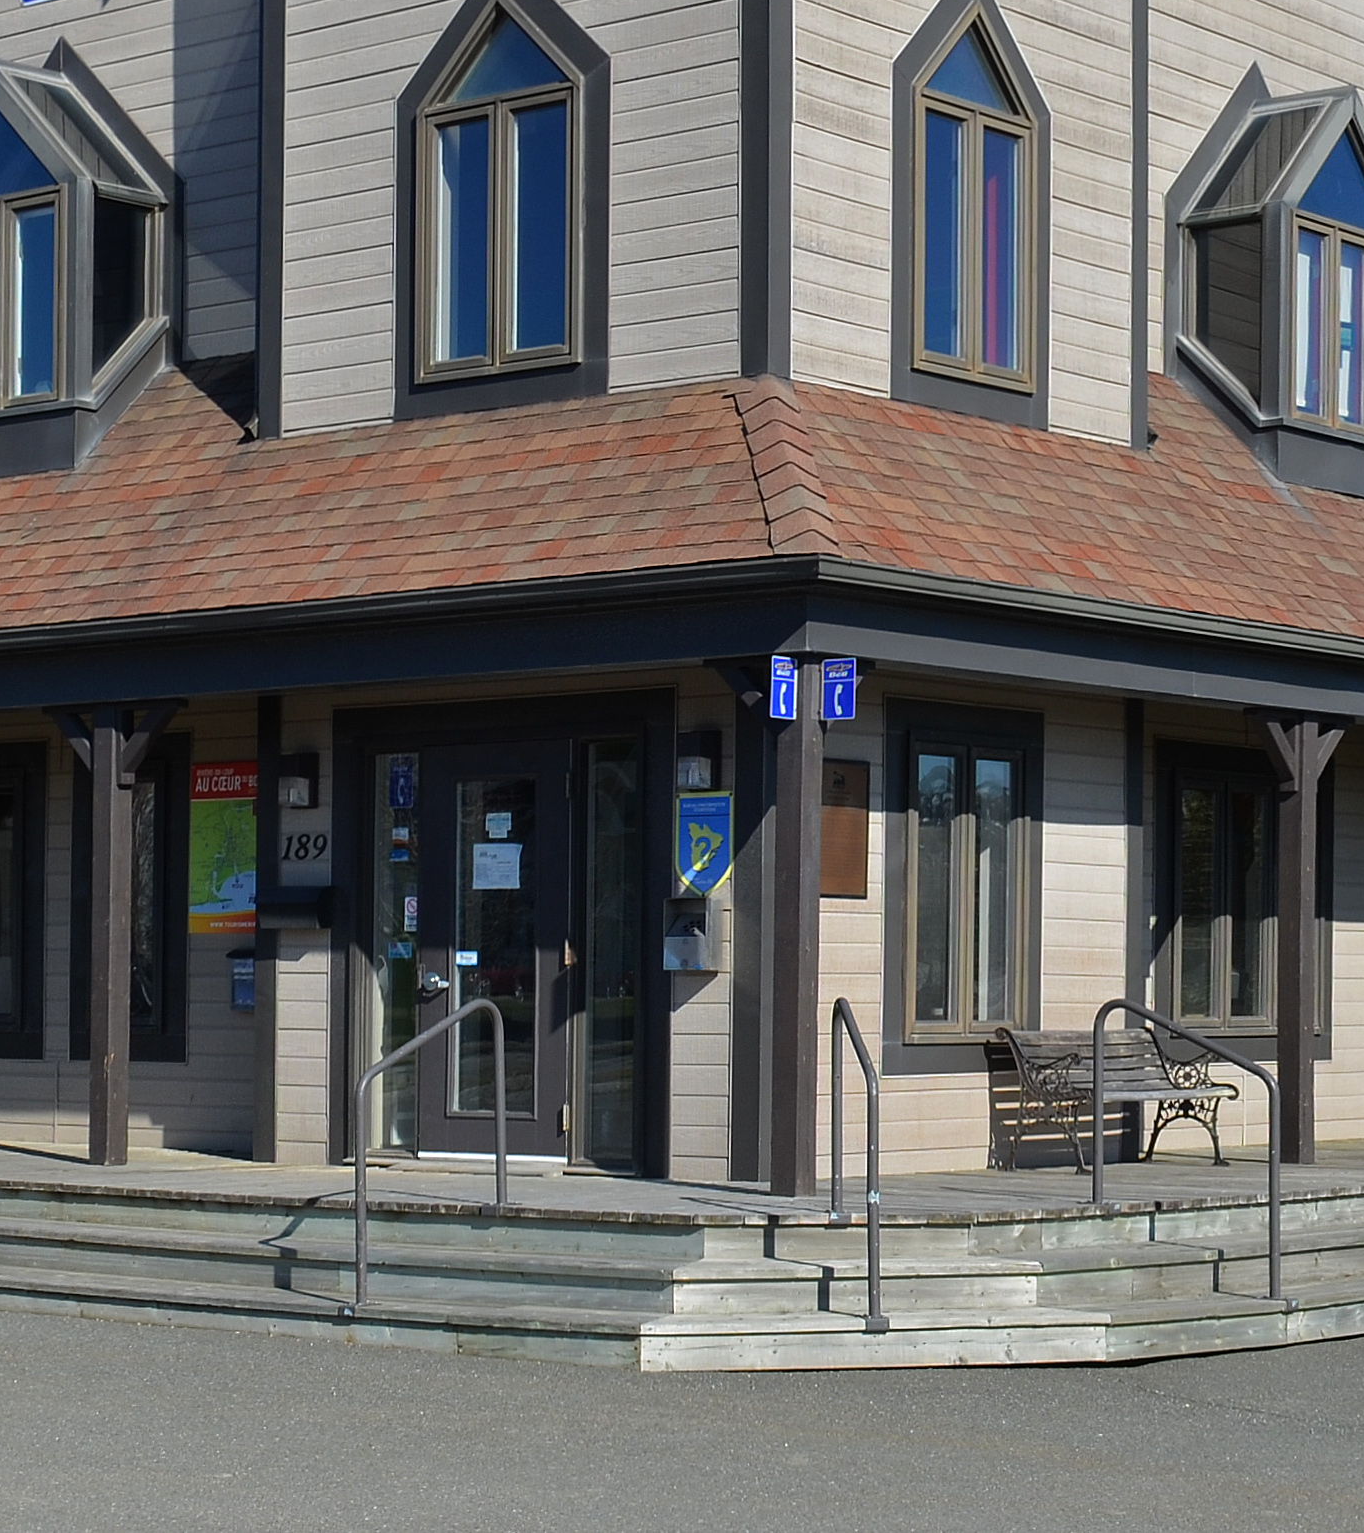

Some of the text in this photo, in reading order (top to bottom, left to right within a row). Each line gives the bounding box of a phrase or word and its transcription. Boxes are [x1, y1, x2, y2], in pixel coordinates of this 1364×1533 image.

[828, 670, 848, 678] Bell
[195, 776, 210, 793] AU
[282, 833, 328, 861] 189
